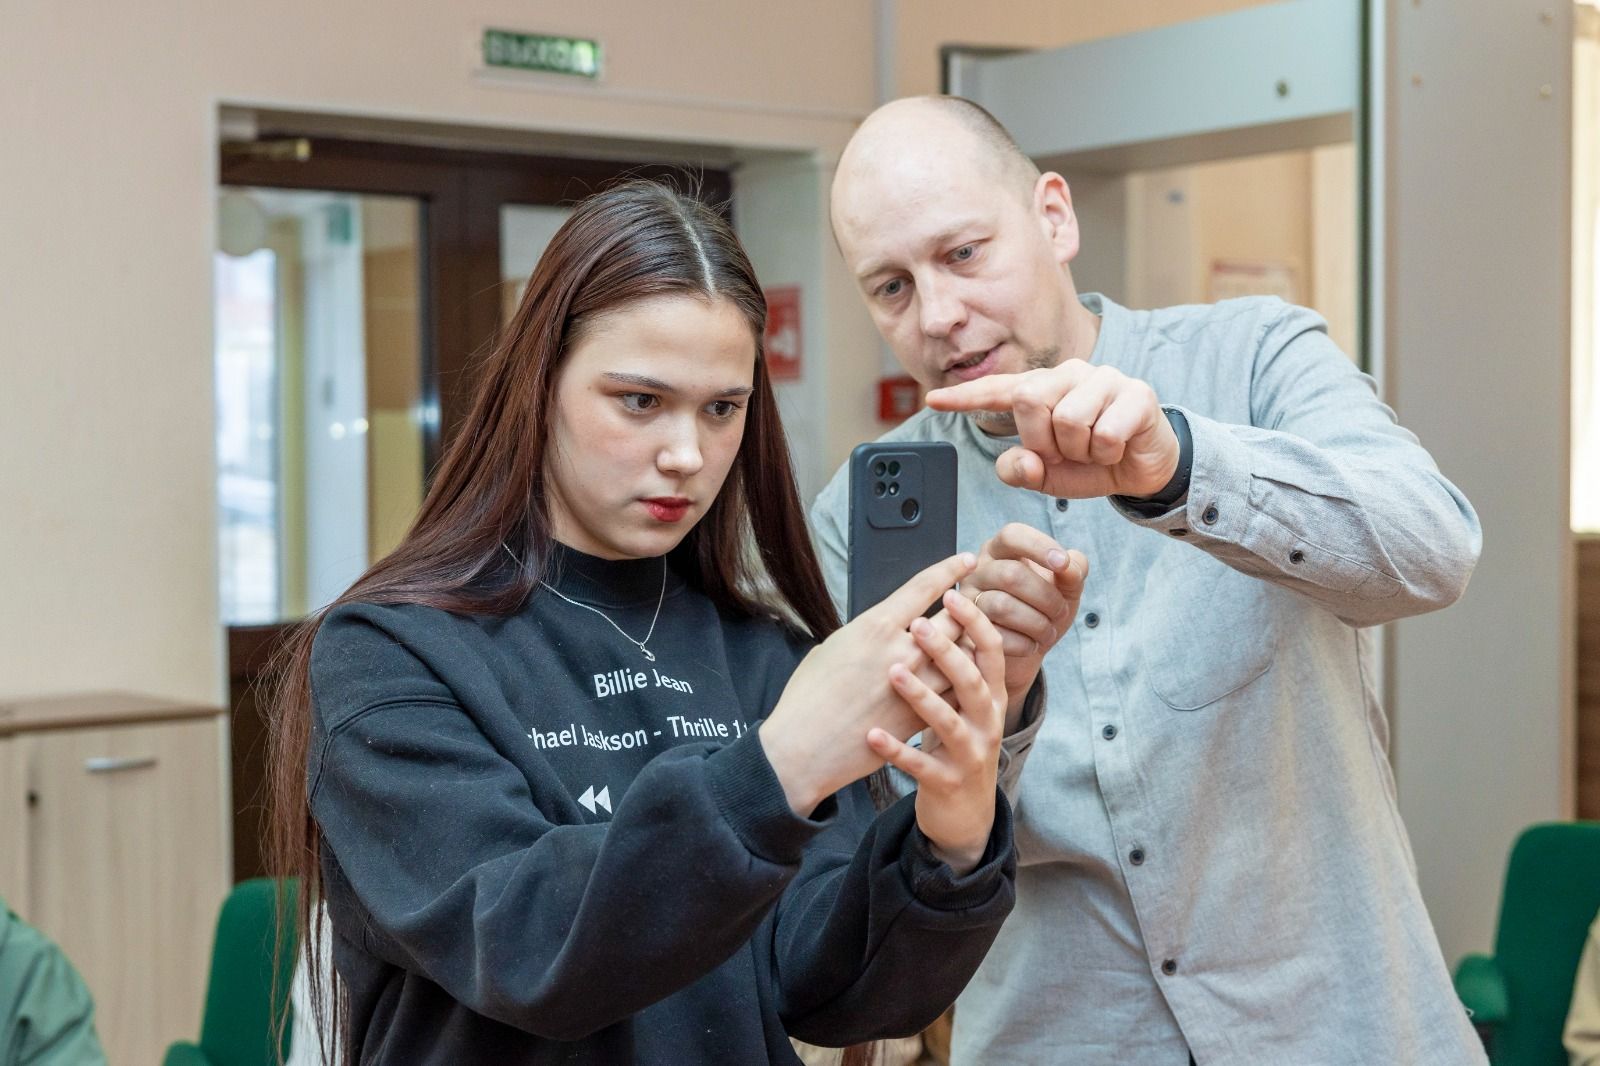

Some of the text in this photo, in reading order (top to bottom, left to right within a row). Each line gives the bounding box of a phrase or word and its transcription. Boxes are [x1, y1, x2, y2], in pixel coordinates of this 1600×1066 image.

[593, 668, 694, 698] Billie Jean
[527, 723, 578, 749] hael
[580, 724, 648, 751] Jaskson
[666, 715, 729, 738] Thrille
